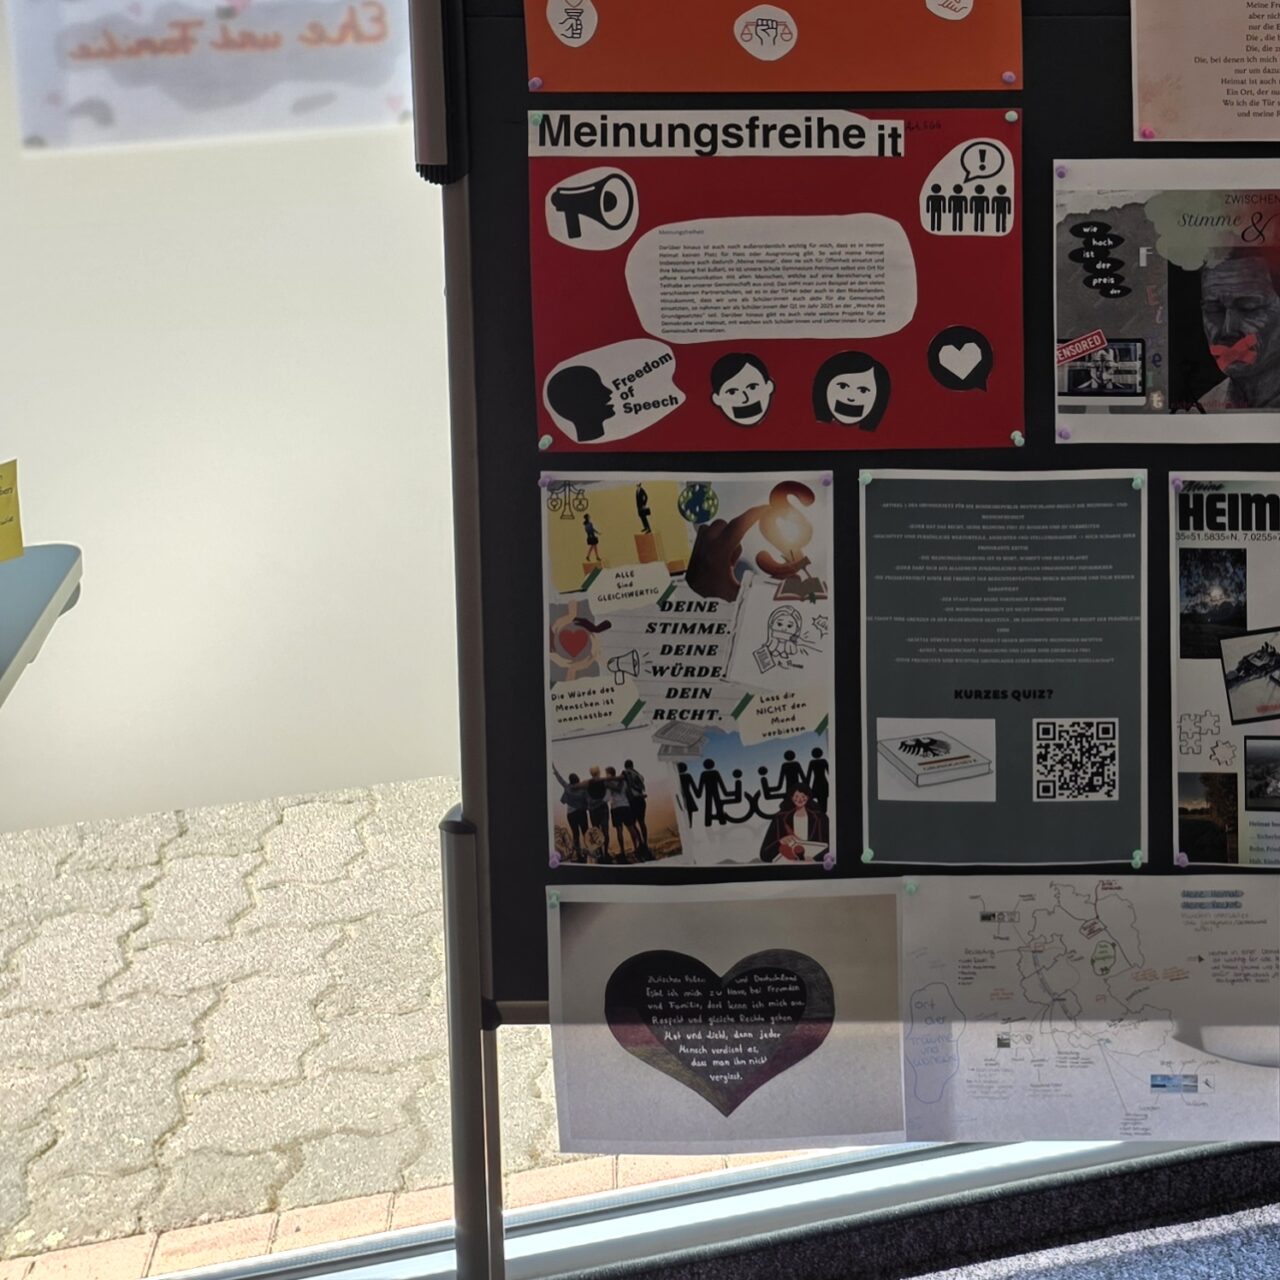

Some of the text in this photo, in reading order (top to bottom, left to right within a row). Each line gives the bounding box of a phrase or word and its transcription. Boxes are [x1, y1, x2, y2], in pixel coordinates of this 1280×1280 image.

[1083, 225, 1098, 234] wie
[1177, 212, 1280, 243] Stimme &
[1093, 237, 1113, 247] hoch
[1083, 249, 1095, 259] ist
[1096, 261, 1112, 270] der
[1093, 275, 1115, 286] preis
[1057, 334, 1102, 362] ENSORED
[611, 351, 673, 391] Freedom
[620, 386, 636, 401] of
[622, 395, 679, 416] Speech
[615, 571, 635, 579] ALLE
[598, 588, 659, 602] GLEICHWERTIG
[660, 600, 719, 612] DEINE
[645, 622, 731, 635] STIMME.
[660, 644, 719, 656] DEINE
[651, 663, 727, 678] WÜRDE.
[551, 686, 614, 701] Die des
[665, 688, 712, 699] DEIN
[760, 692, 795, 703] Lass dir
[954, 689, 1054, 701] KURZES QUIZ?
[556, 701, 599, 712] Menschen
[756, 702, 807, 715] NICHT den
[558, 710, 612, 723] unantastbar
[653, 709, 722, 721] RECHT.
[771, 715, 795, 724] Mund
[762, 726, 806, 737] verbieten
